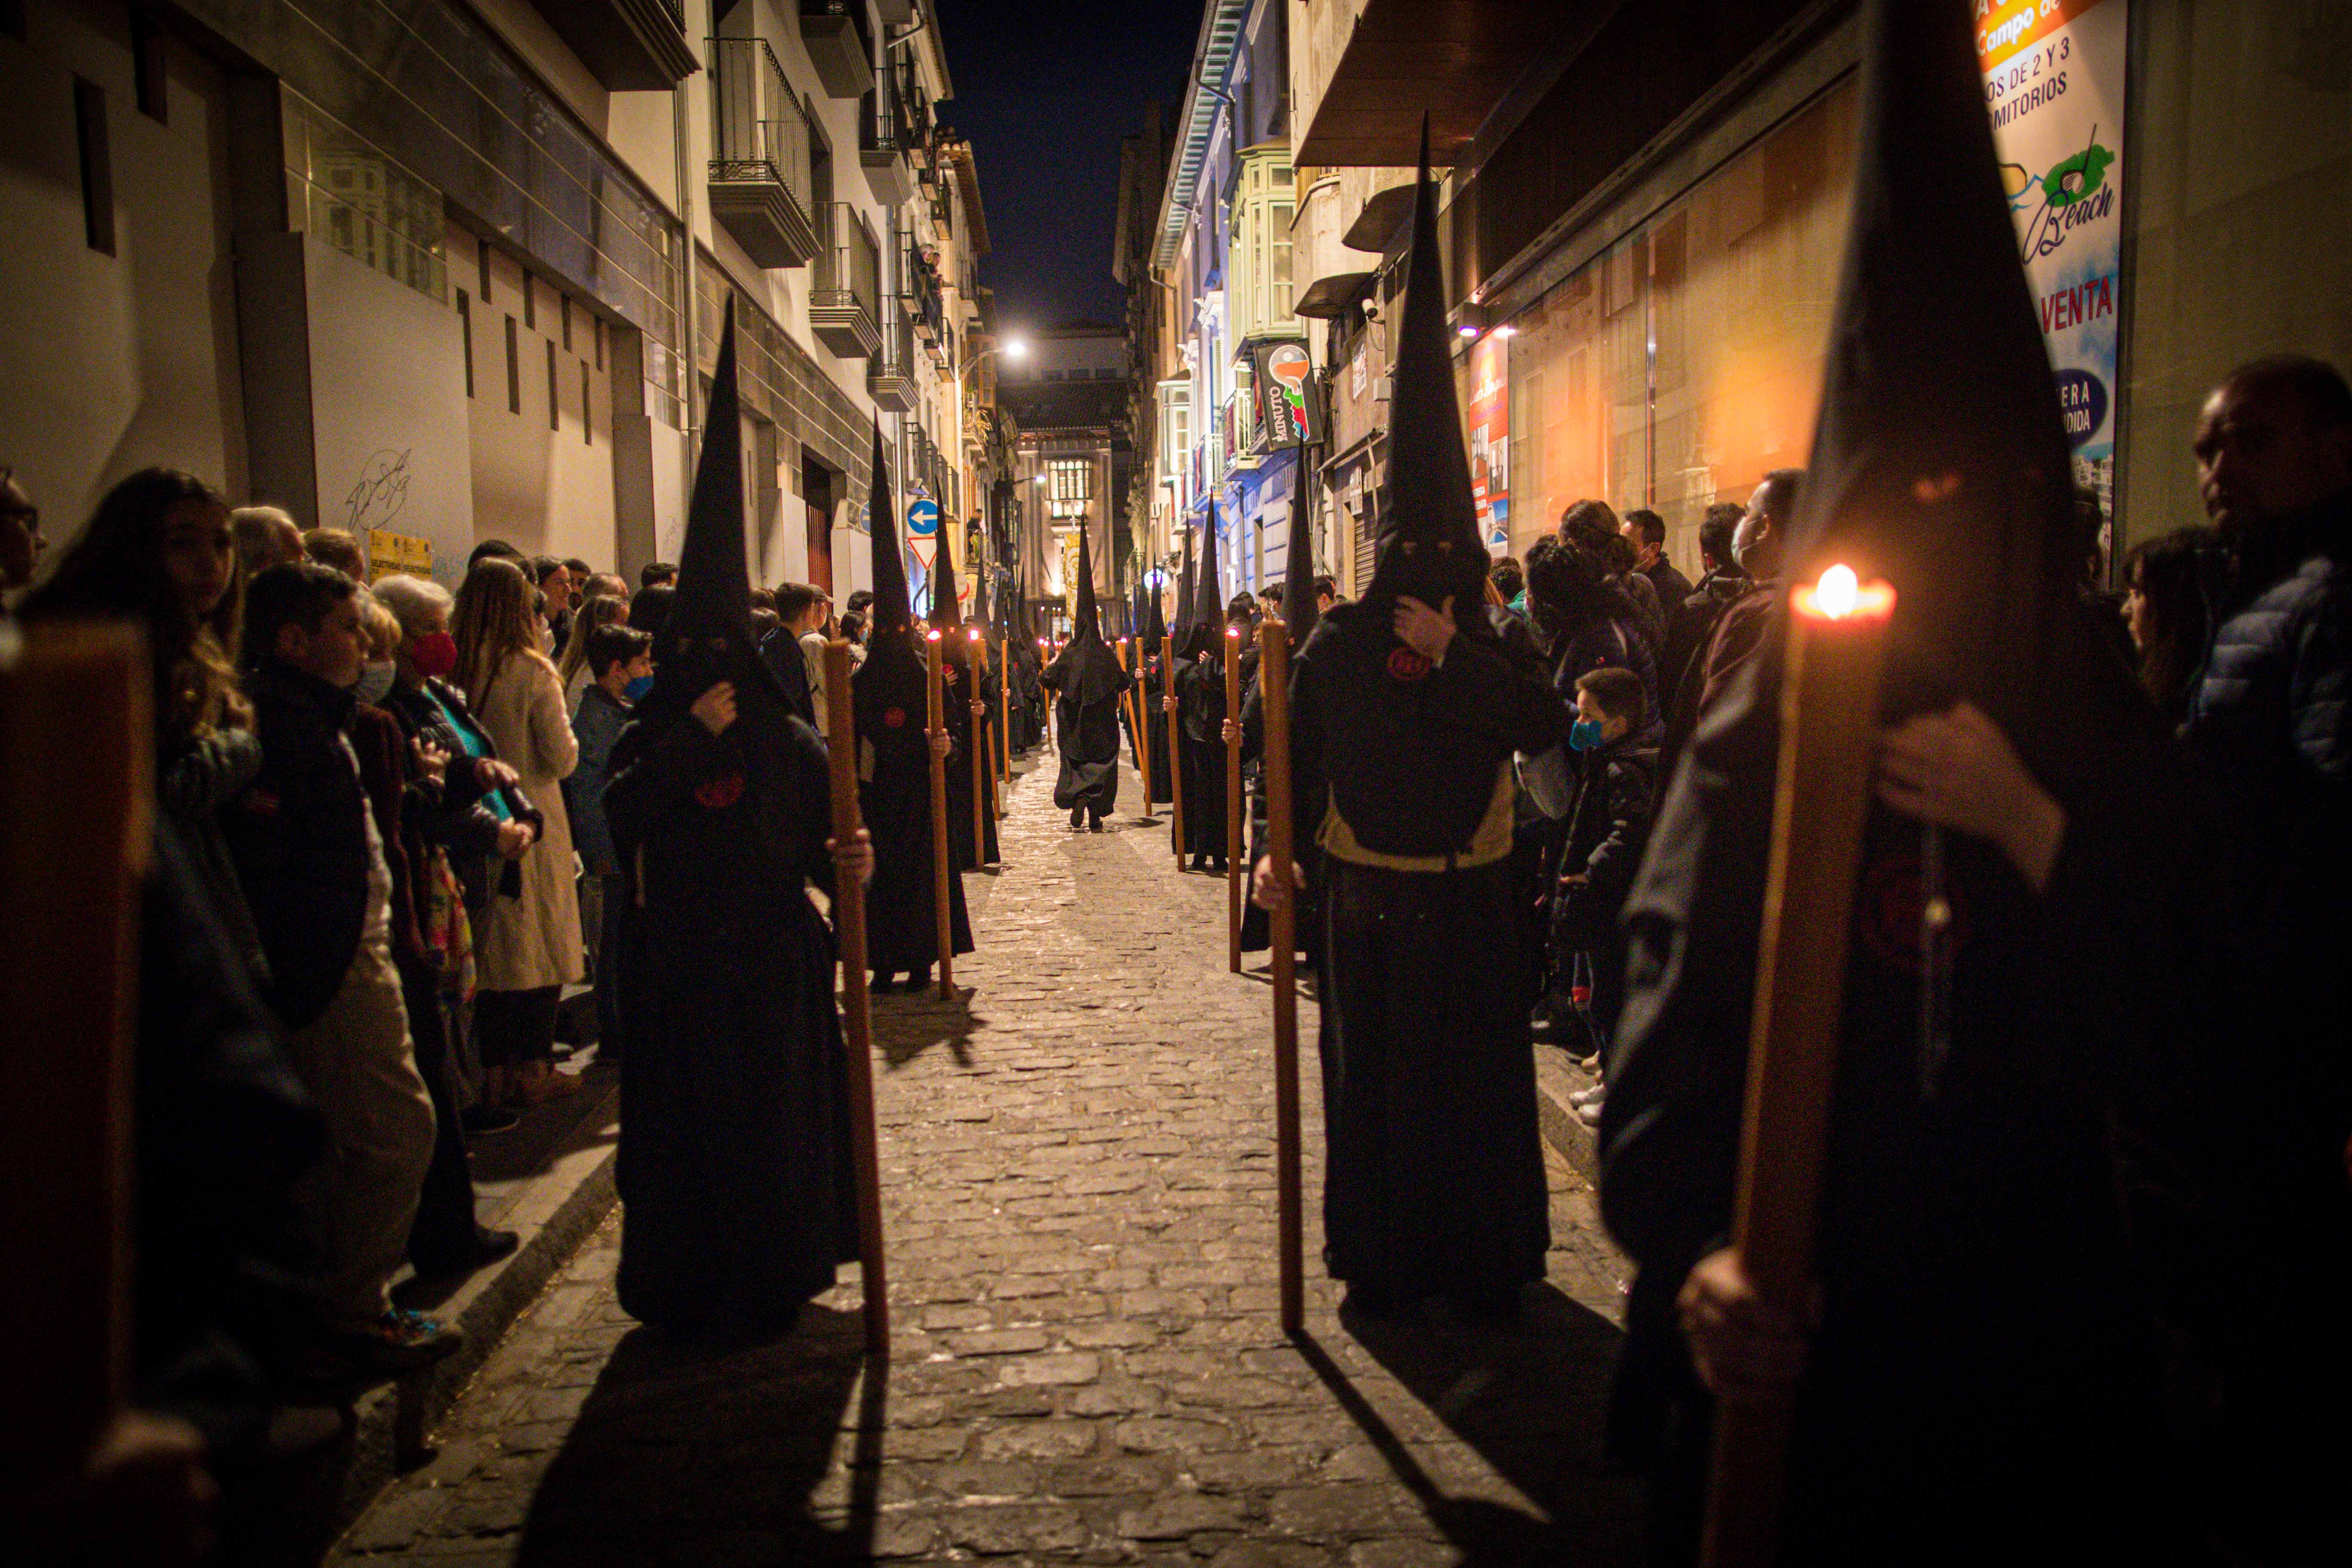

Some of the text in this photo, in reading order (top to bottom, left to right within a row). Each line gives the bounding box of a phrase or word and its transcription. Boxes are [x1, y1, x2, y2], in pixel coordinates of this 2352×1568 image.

[1976, 6, 2035, 56] Campo
[2010, 61, 2027, 91] DE
[2032, 54, 2041, 77] 2
[2046, 43, 2057, 68] Y
[2061, 36, 2070, 60] 3
[1991, 71, 2067, 131] MITORIOS
[2022, 182, 2114, 265] Beach
[2041, 276, 2113, 334] VENTA
[1269, 386, 1288, 442] MINUTO
[2057, 381, 2091, 407] ERA
